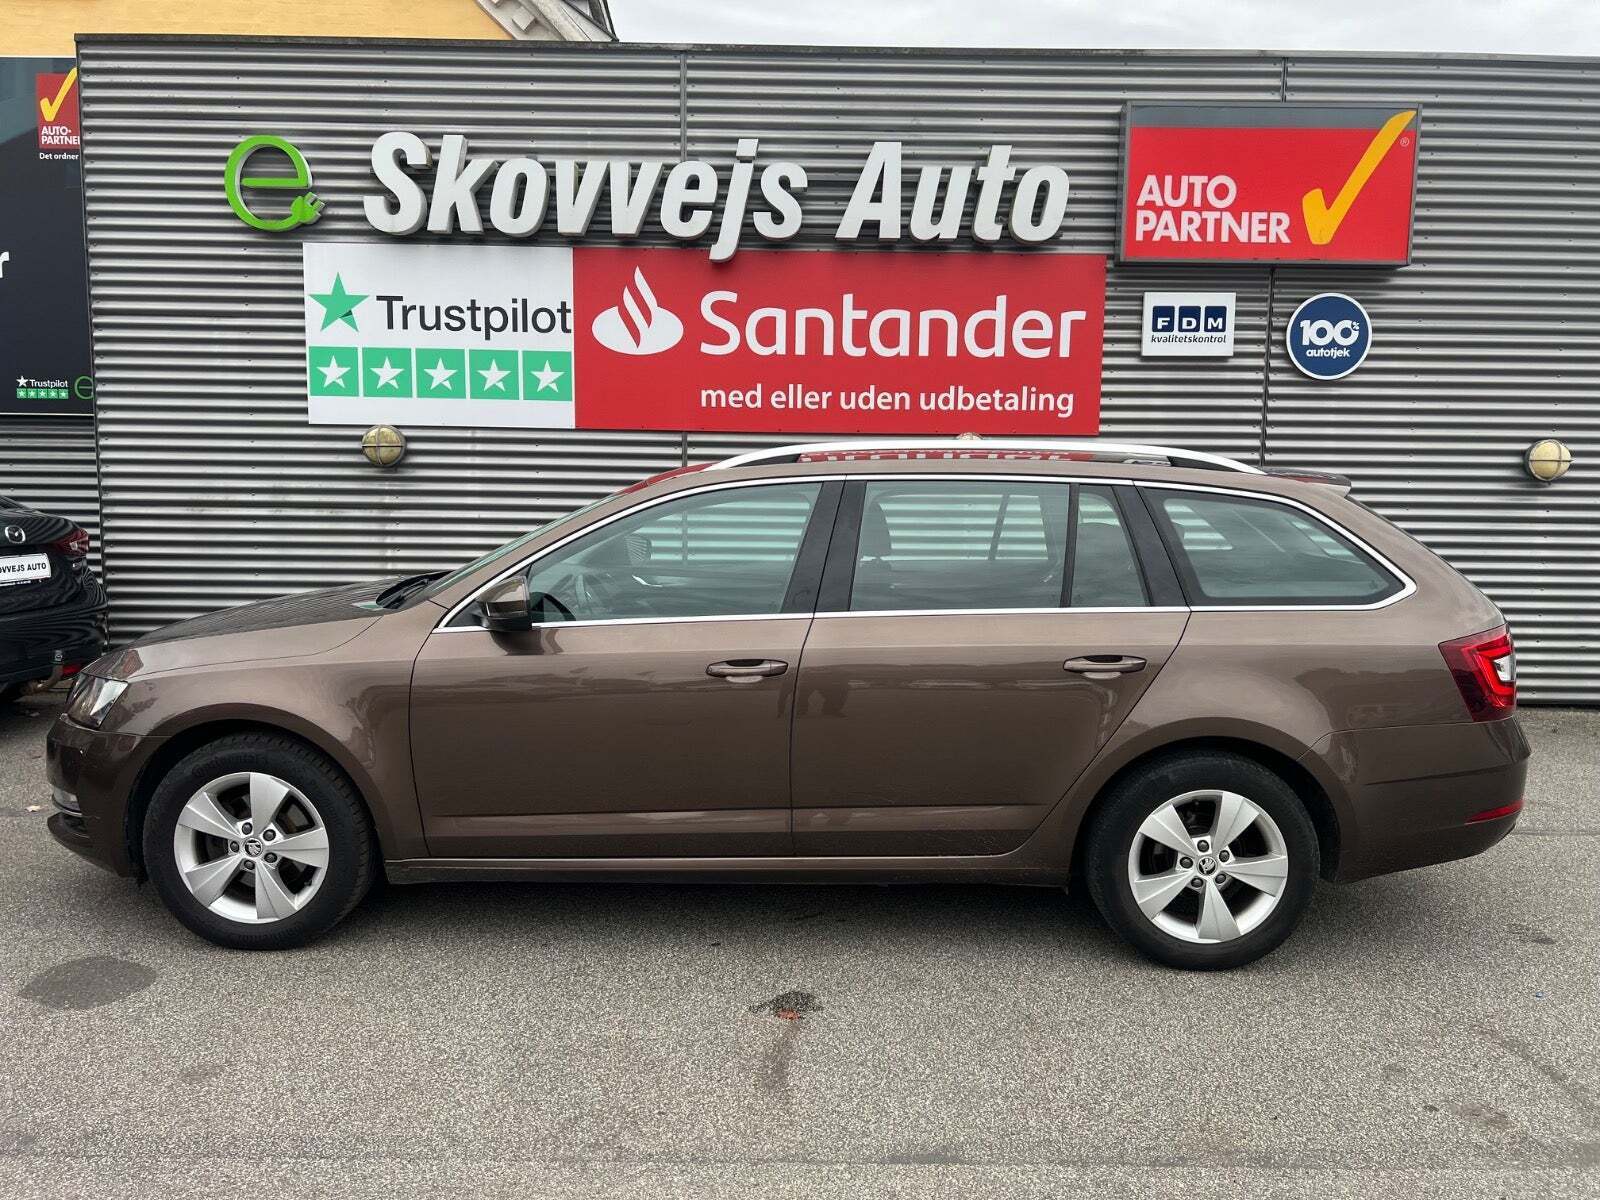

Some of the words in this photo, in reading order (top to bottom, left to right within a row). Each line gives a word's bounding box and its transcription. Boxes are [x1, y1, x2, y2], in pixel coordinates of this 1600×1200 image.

[39, 152, 53, 160] Det
[53, 152, 79, 160] ordner
[363, 131, 808, 263] Skovvejs
[835, 141, 1070, 245] Auto
[1135, 174, 1237, 209] AUTO
[1135, 210, 1292, 244] PARTNER
[375, 294, 572, 340] Trustpilot
[699, 290, 1087, 358] Santander
[1151, 334, 1227, 344] kvalitetskontrol
[1305, 346, 1351, 359] autotjek
[29, 379, 68, 388] Trustpilot
[701, 383, 762, 409] med
[770, 384, 831, 410] eller
[839, 385, 911, 411] uden
[919, 386, 1075, 418] udbetaling
[27, 562, 47, 571] AUTO
